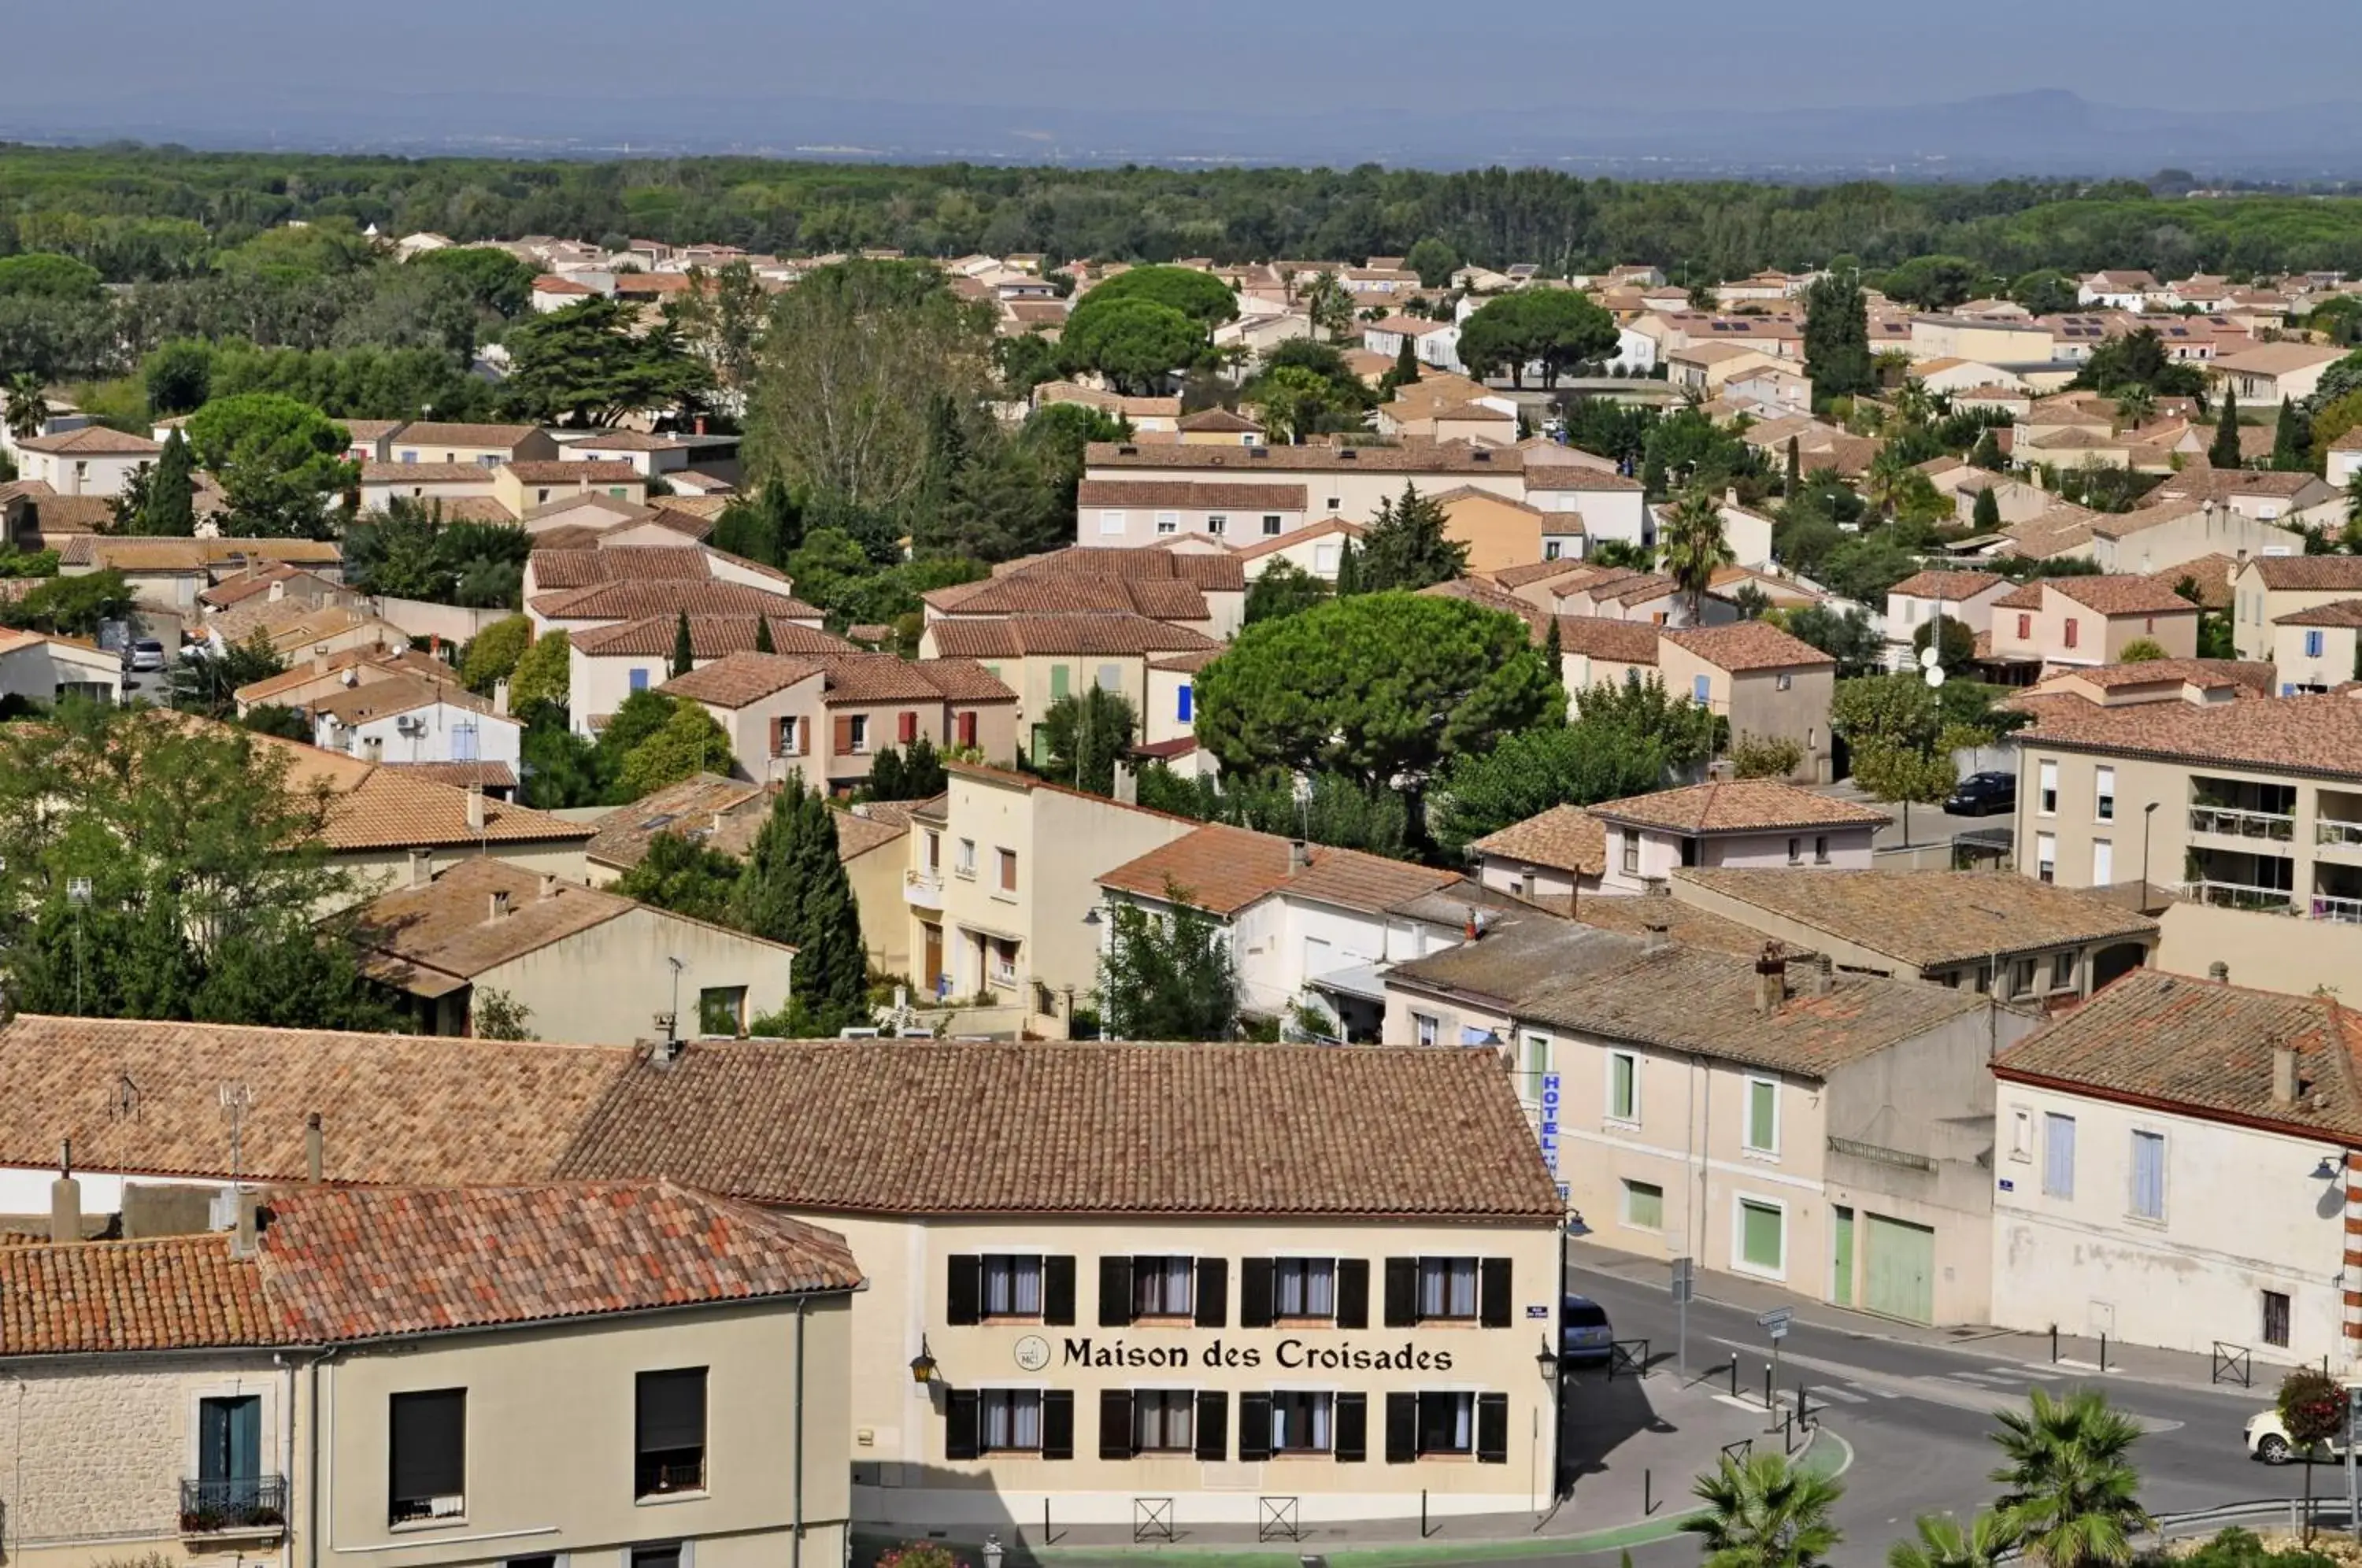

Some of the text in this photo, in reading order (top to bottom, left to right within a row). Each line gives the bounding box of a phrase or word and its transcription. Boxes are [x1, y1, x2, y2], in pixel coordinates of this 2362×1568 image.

[1543, 1075, 1560, 1151] HOTEL
[1063, 1338, 1453, 1371] Maison des Croisades
